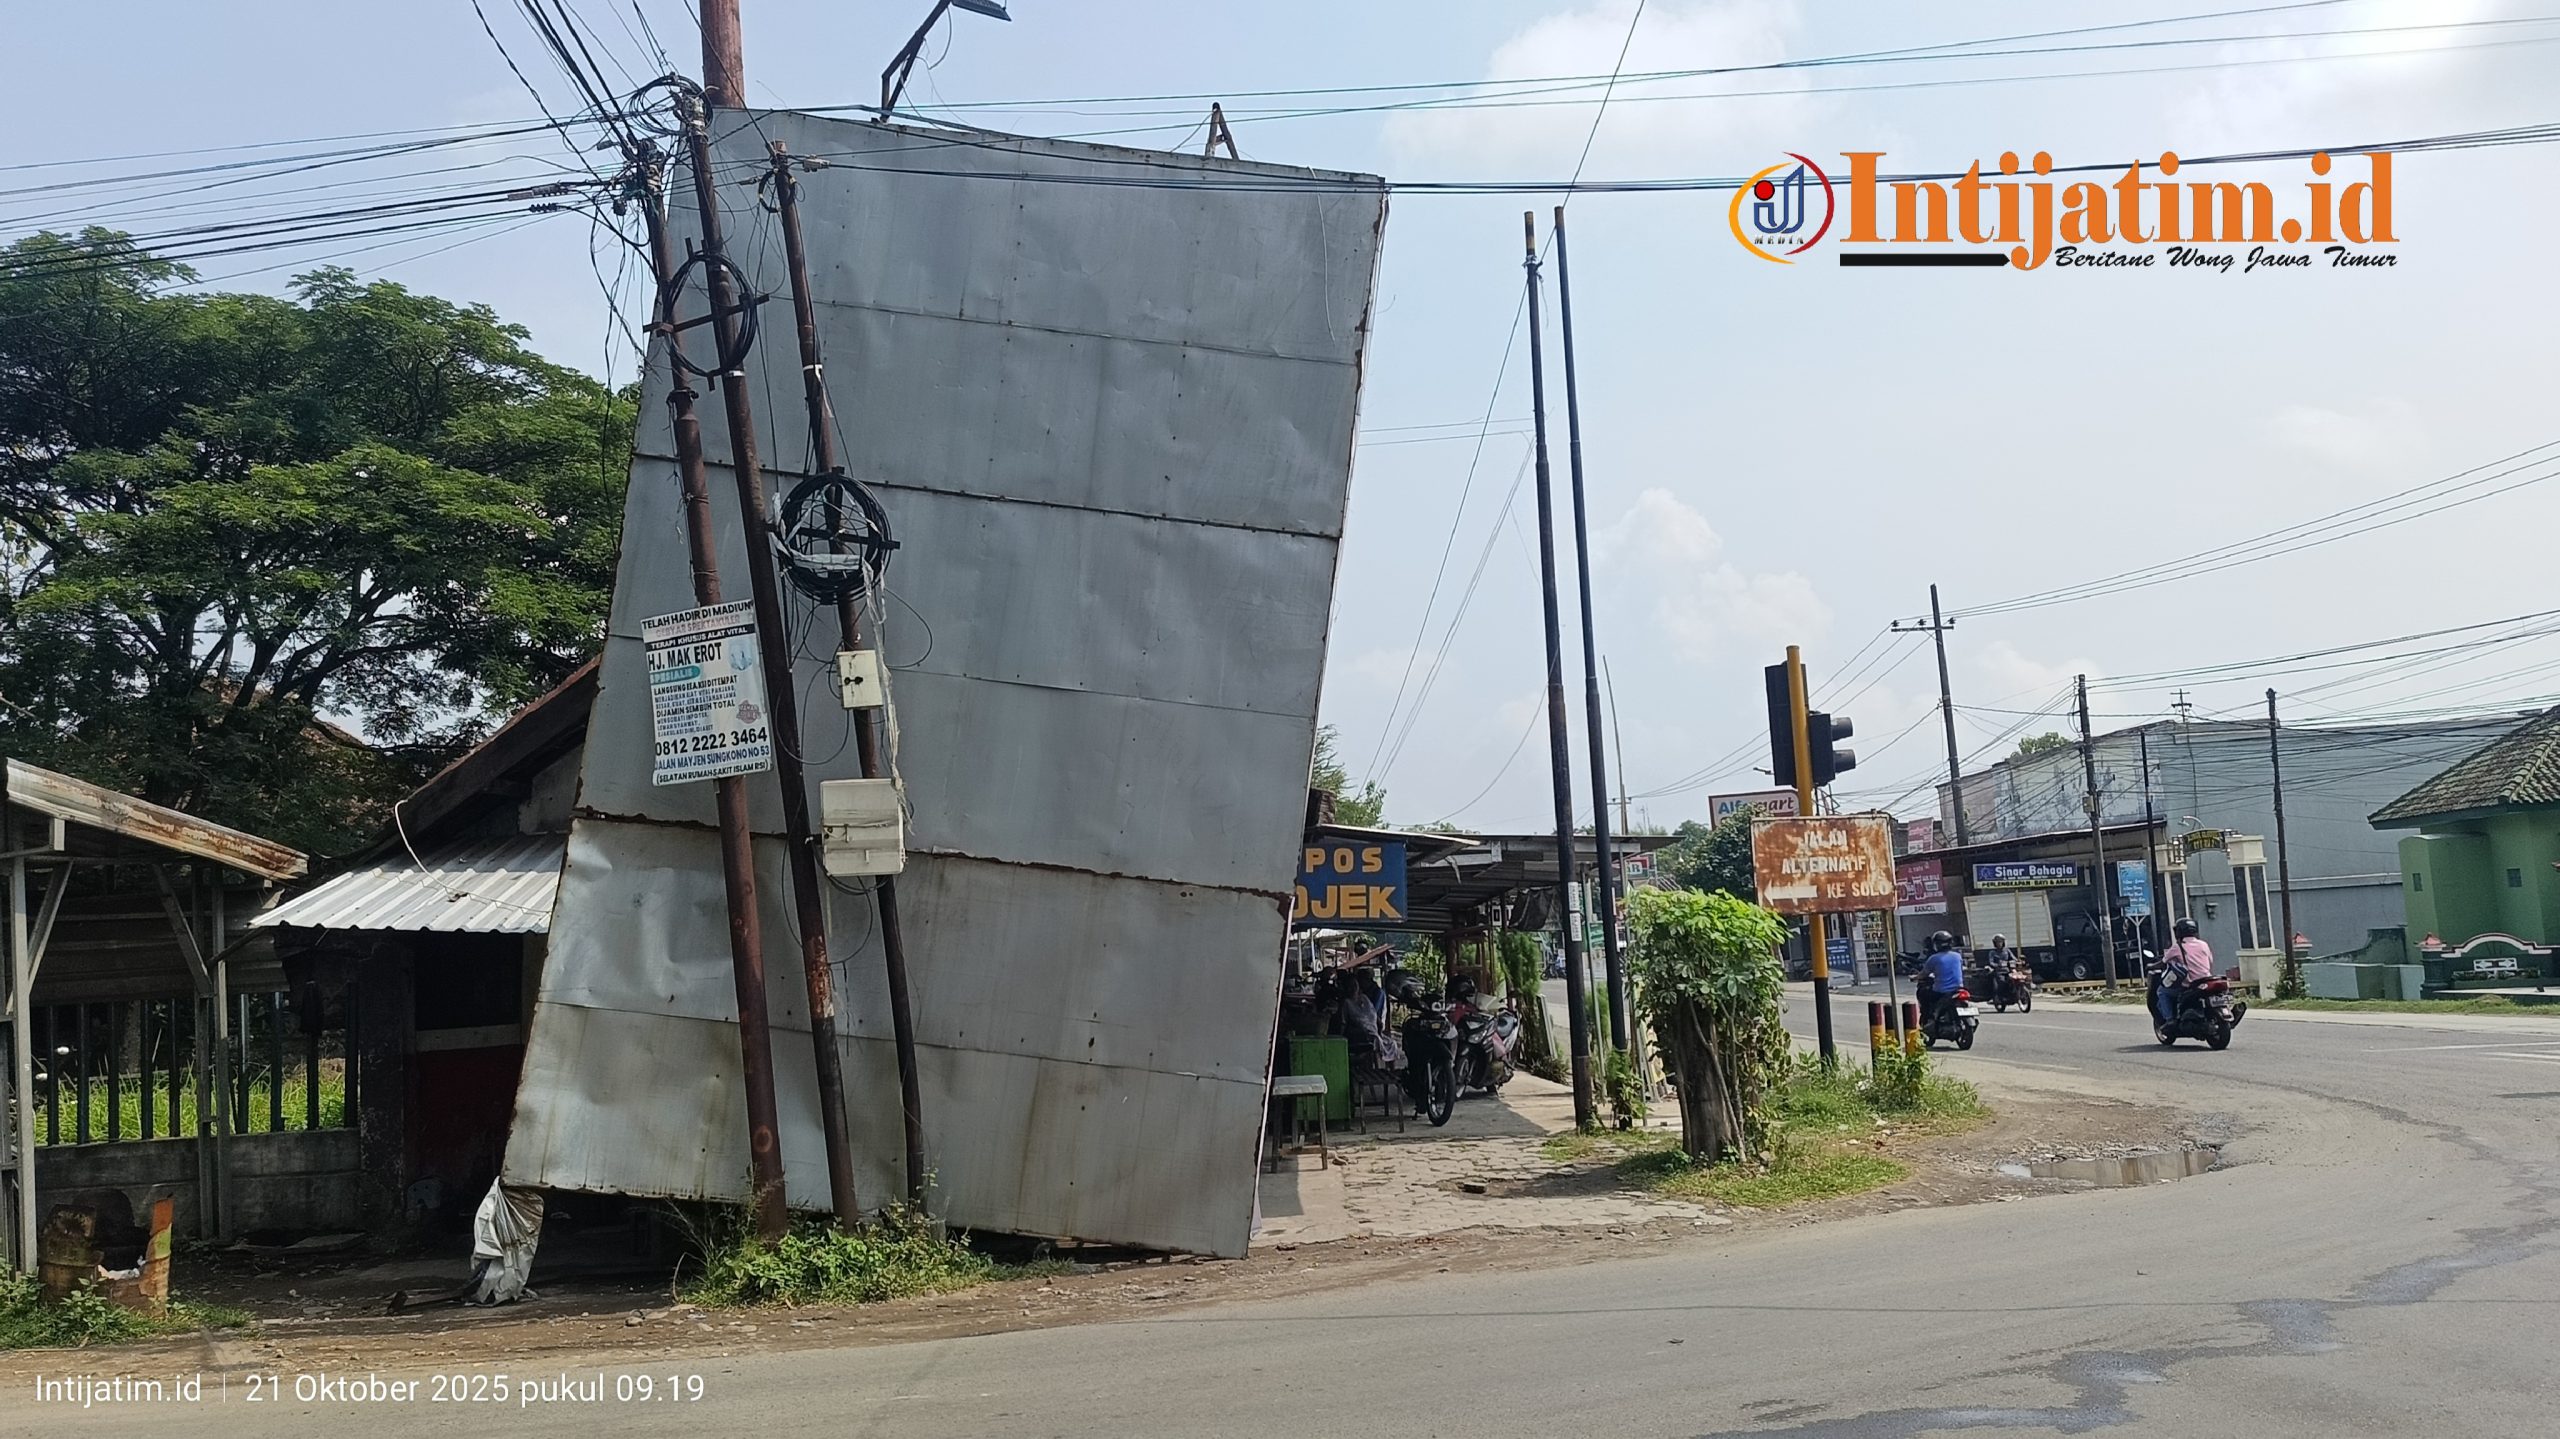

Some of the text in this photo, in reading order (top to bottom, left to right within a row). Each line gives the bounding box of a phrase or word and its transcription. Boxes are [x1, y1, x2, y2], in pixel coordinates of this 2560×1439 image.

[642, 601, 751, 630] TELAH HADIR DI MADIUN
[651, 627, 748, 650] TERAPI KHUSUS ALAT VITAL
[648, 642, 722, 672] HJ. MAK EROT
[654, 683, 686, 696] LANGSUNG
[656, 699, 736, 718] DIJAMIN SEMBUH TOTAL
[656, 727, 768, 756] 0812 2222 3464
[677, 755, 706, 769] MAYJEN
[707, 750, 748, 764] SUNGKONO
[748, 747, 760, 758] NO
[761, 745, 770, 756] 53
[733, 763, 754, 773] ISLAM
[1718, 797, 1795, 815] Alfart
[1804, 829, 1848, 849] JALAN
[1305, 847, 1383, 873] POS
[1781, 855, 1867, 875] ALTERNATIF
[1995, 866, 2025, 878] Sinar
[2028, 865, 2073, 878] Bahagia
[1827, 881, 1890, 899] KE SOLO
[1981, 880, 2031, 888] PERLENGKAPAN
